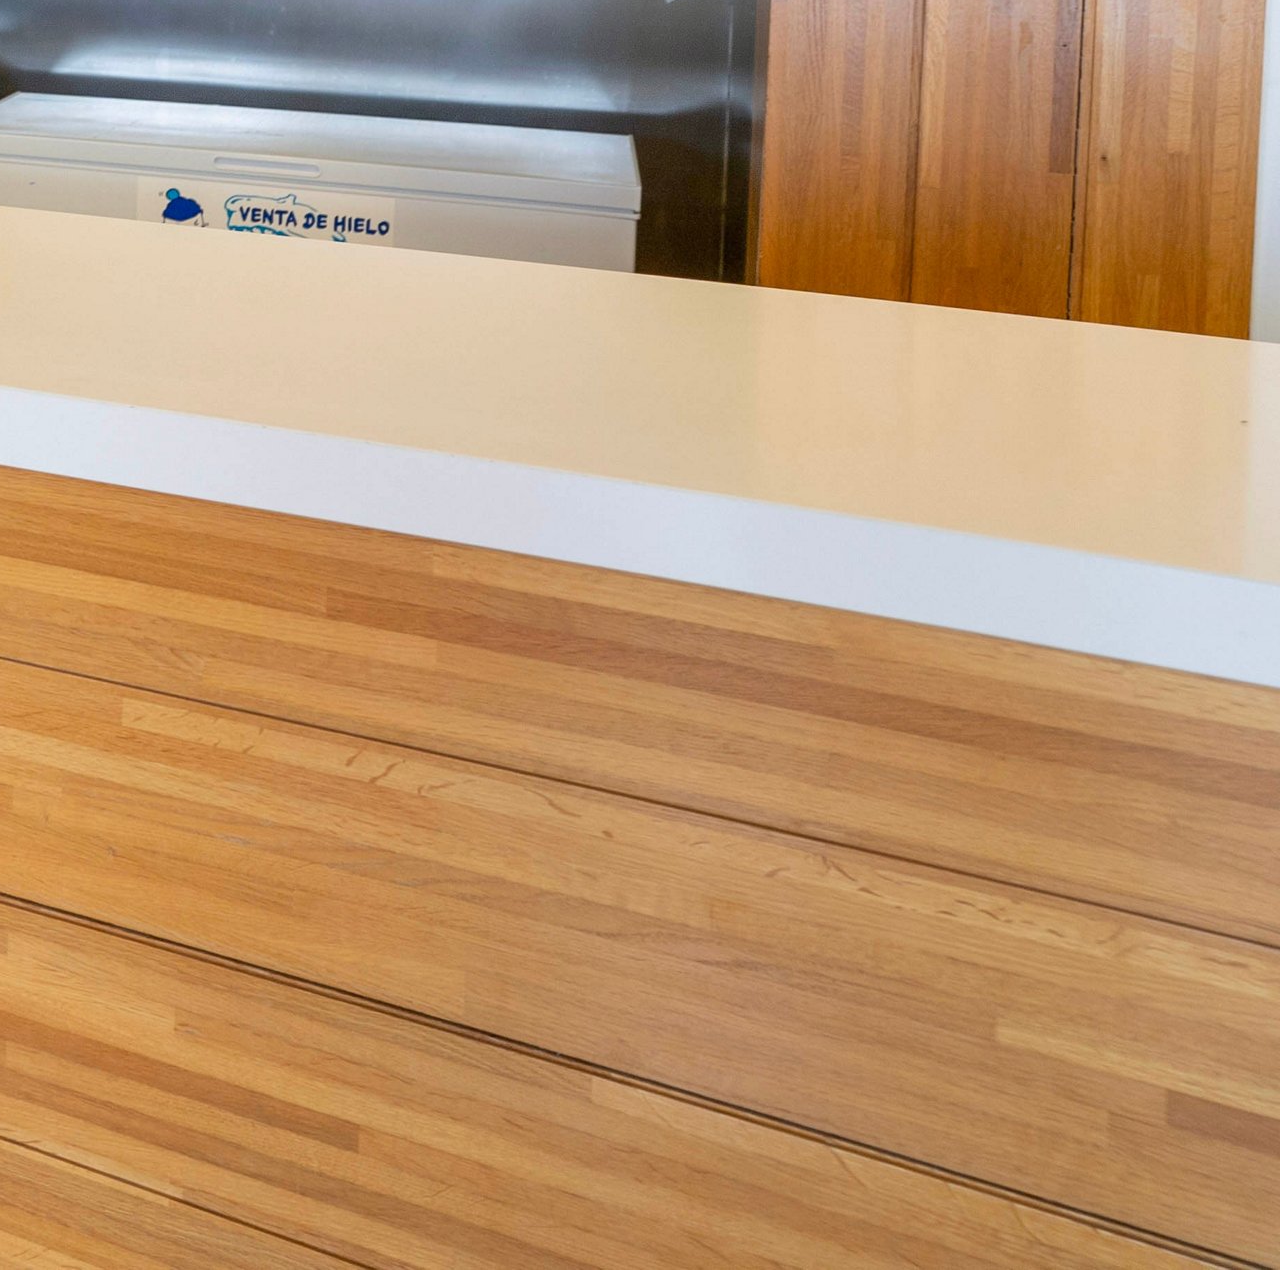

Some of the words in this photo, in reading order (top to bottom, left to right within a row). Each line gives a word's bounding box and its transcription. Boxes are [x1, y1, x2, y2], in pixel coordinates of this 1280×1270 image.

[239, 206, 298, 228] VENTA
[302, 212, 329, 230] DE
[333, 215, 391, 236] HIELO
